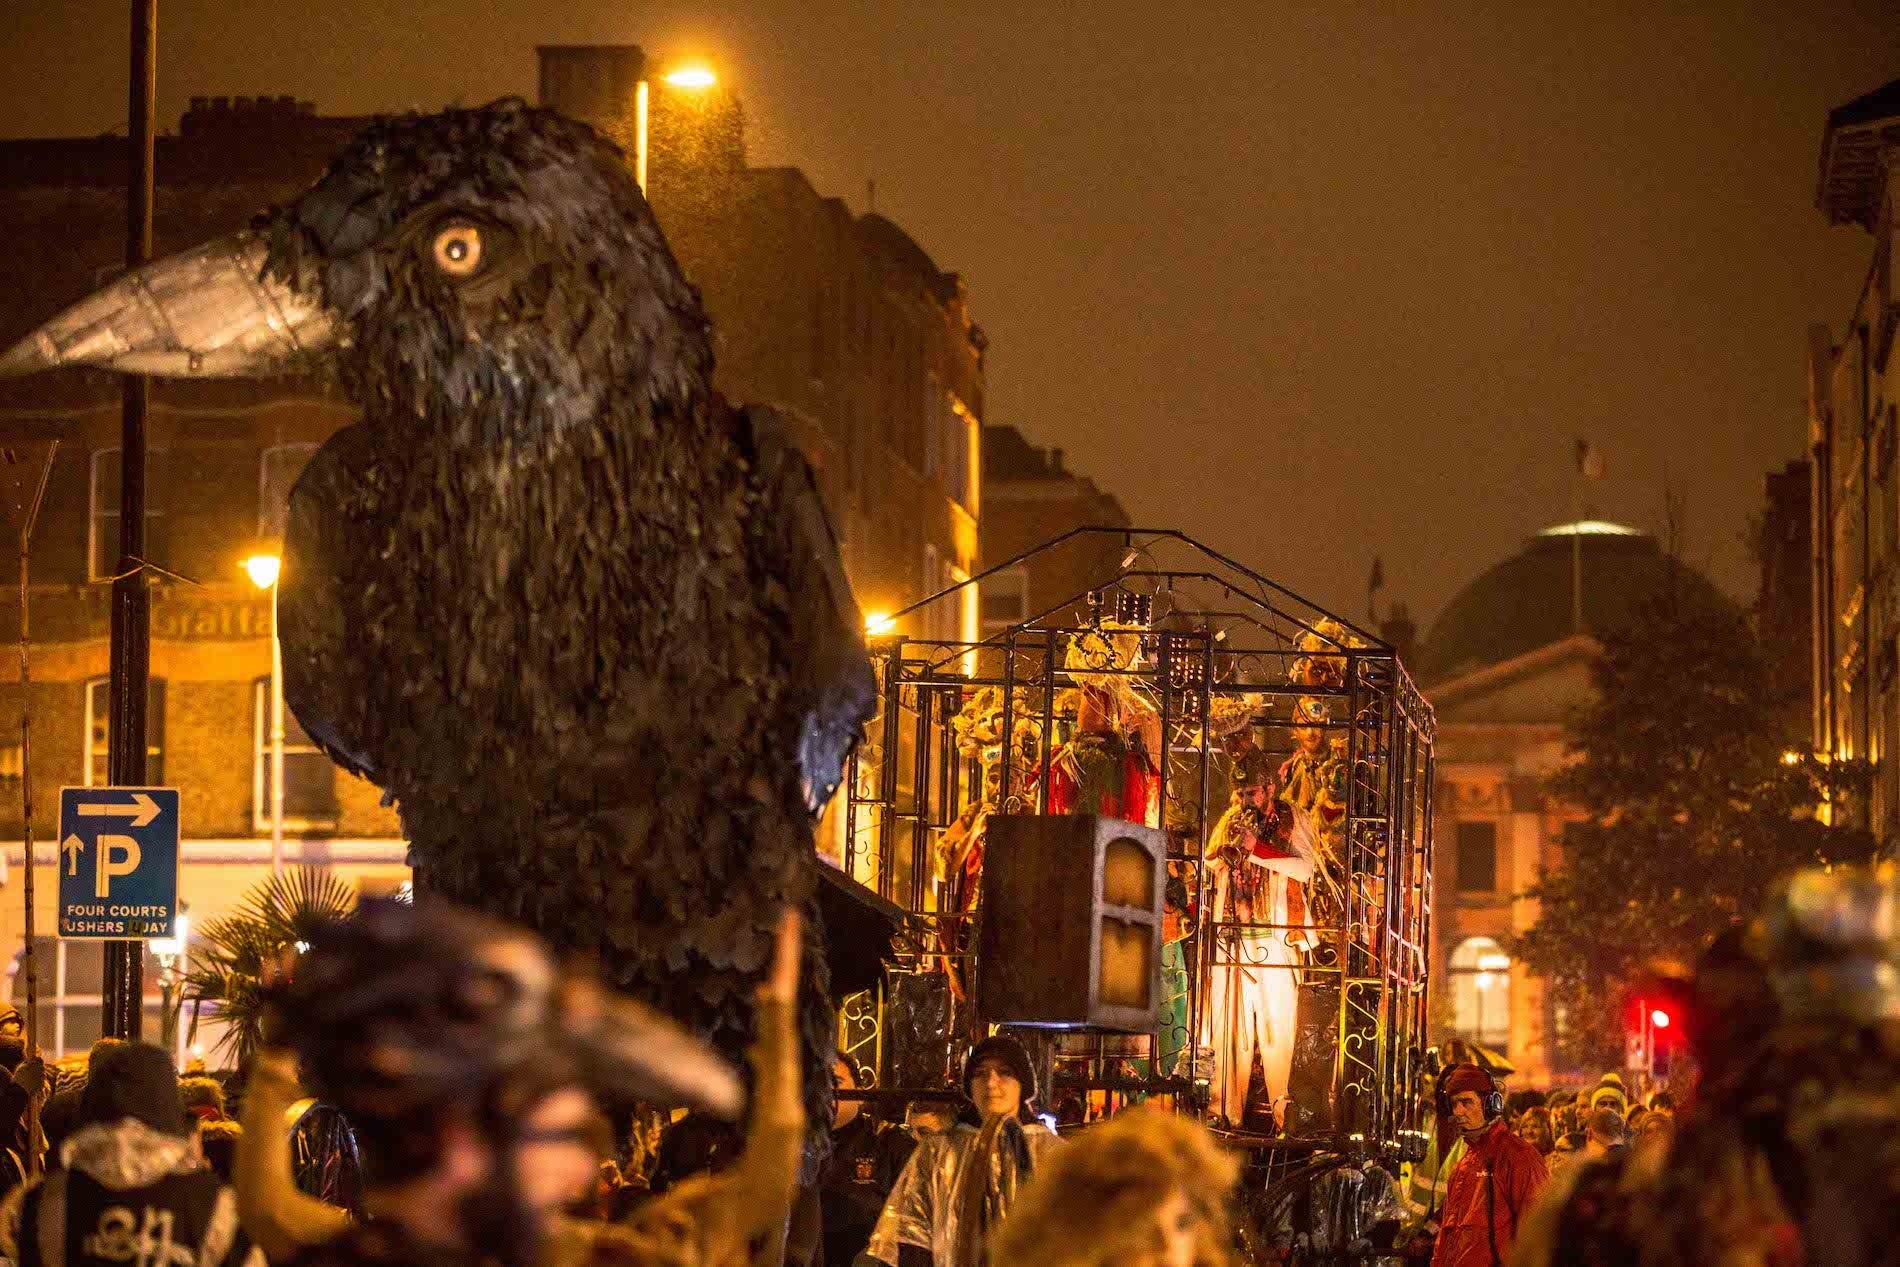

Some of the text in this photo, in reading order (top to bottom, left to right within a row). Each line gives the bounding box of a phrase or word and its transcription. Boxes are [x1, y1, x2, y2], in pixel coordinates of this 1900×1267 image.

[95, 834, 142, 898] P
[67, 905, 167, 918] FOUR COURTS
[66, 921, 124, 933] USHERS
